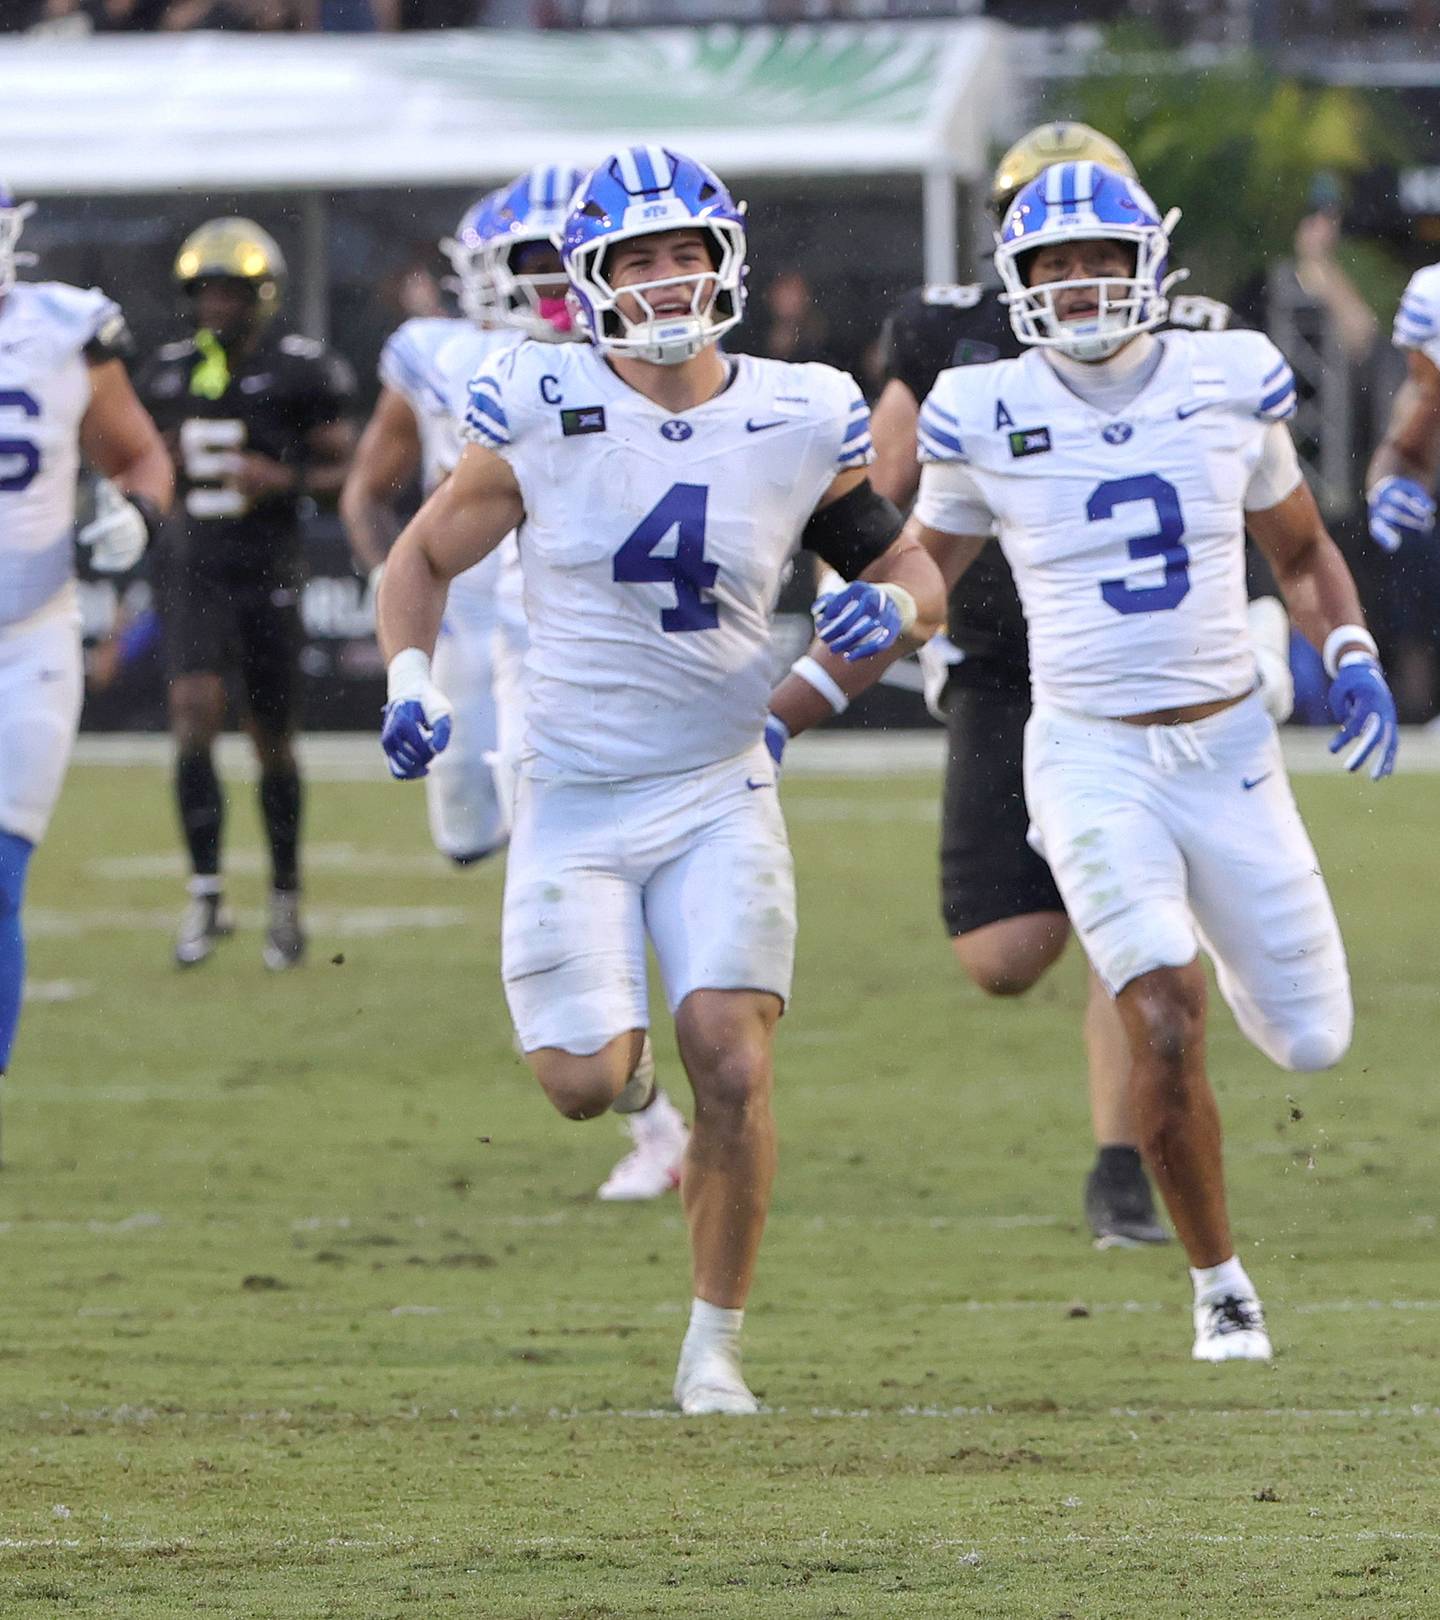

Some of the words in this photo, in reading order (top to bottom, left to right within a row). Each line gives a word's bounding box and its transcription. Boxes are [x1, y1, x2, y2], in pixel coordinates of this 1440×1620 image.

[539, 374, 563, 405] C
[994, 399, 1015, 431] A
[180, 417, 248, 518] 5
[613, 482, 720, 632] 4
[1087, 473, 1190, 615] 3
